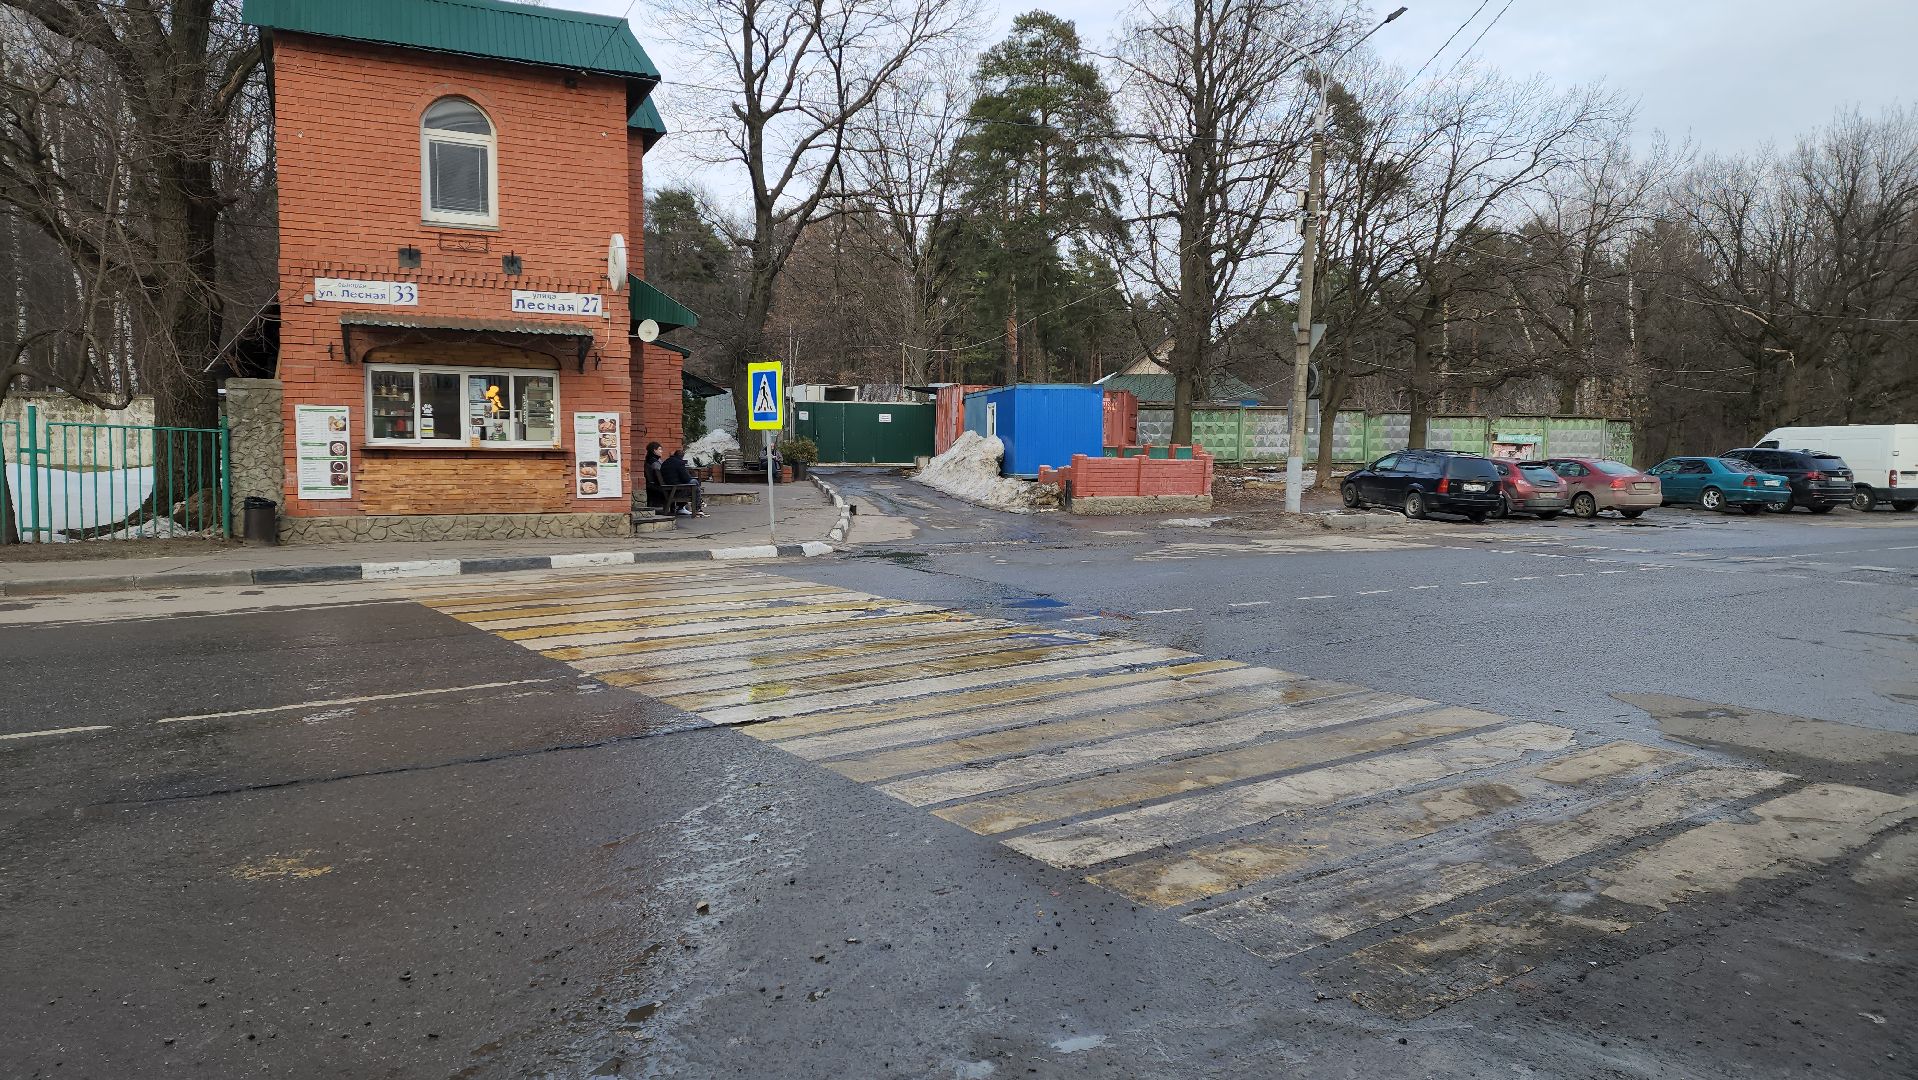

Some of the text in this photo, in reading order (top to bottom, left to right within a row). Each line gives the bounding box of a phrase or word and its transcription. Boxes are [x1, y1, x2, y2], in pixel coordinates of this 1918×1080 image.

[319, 285, 415, 303] ул. Лесная 33
[514, 296, 599, 313] Лесная 27
